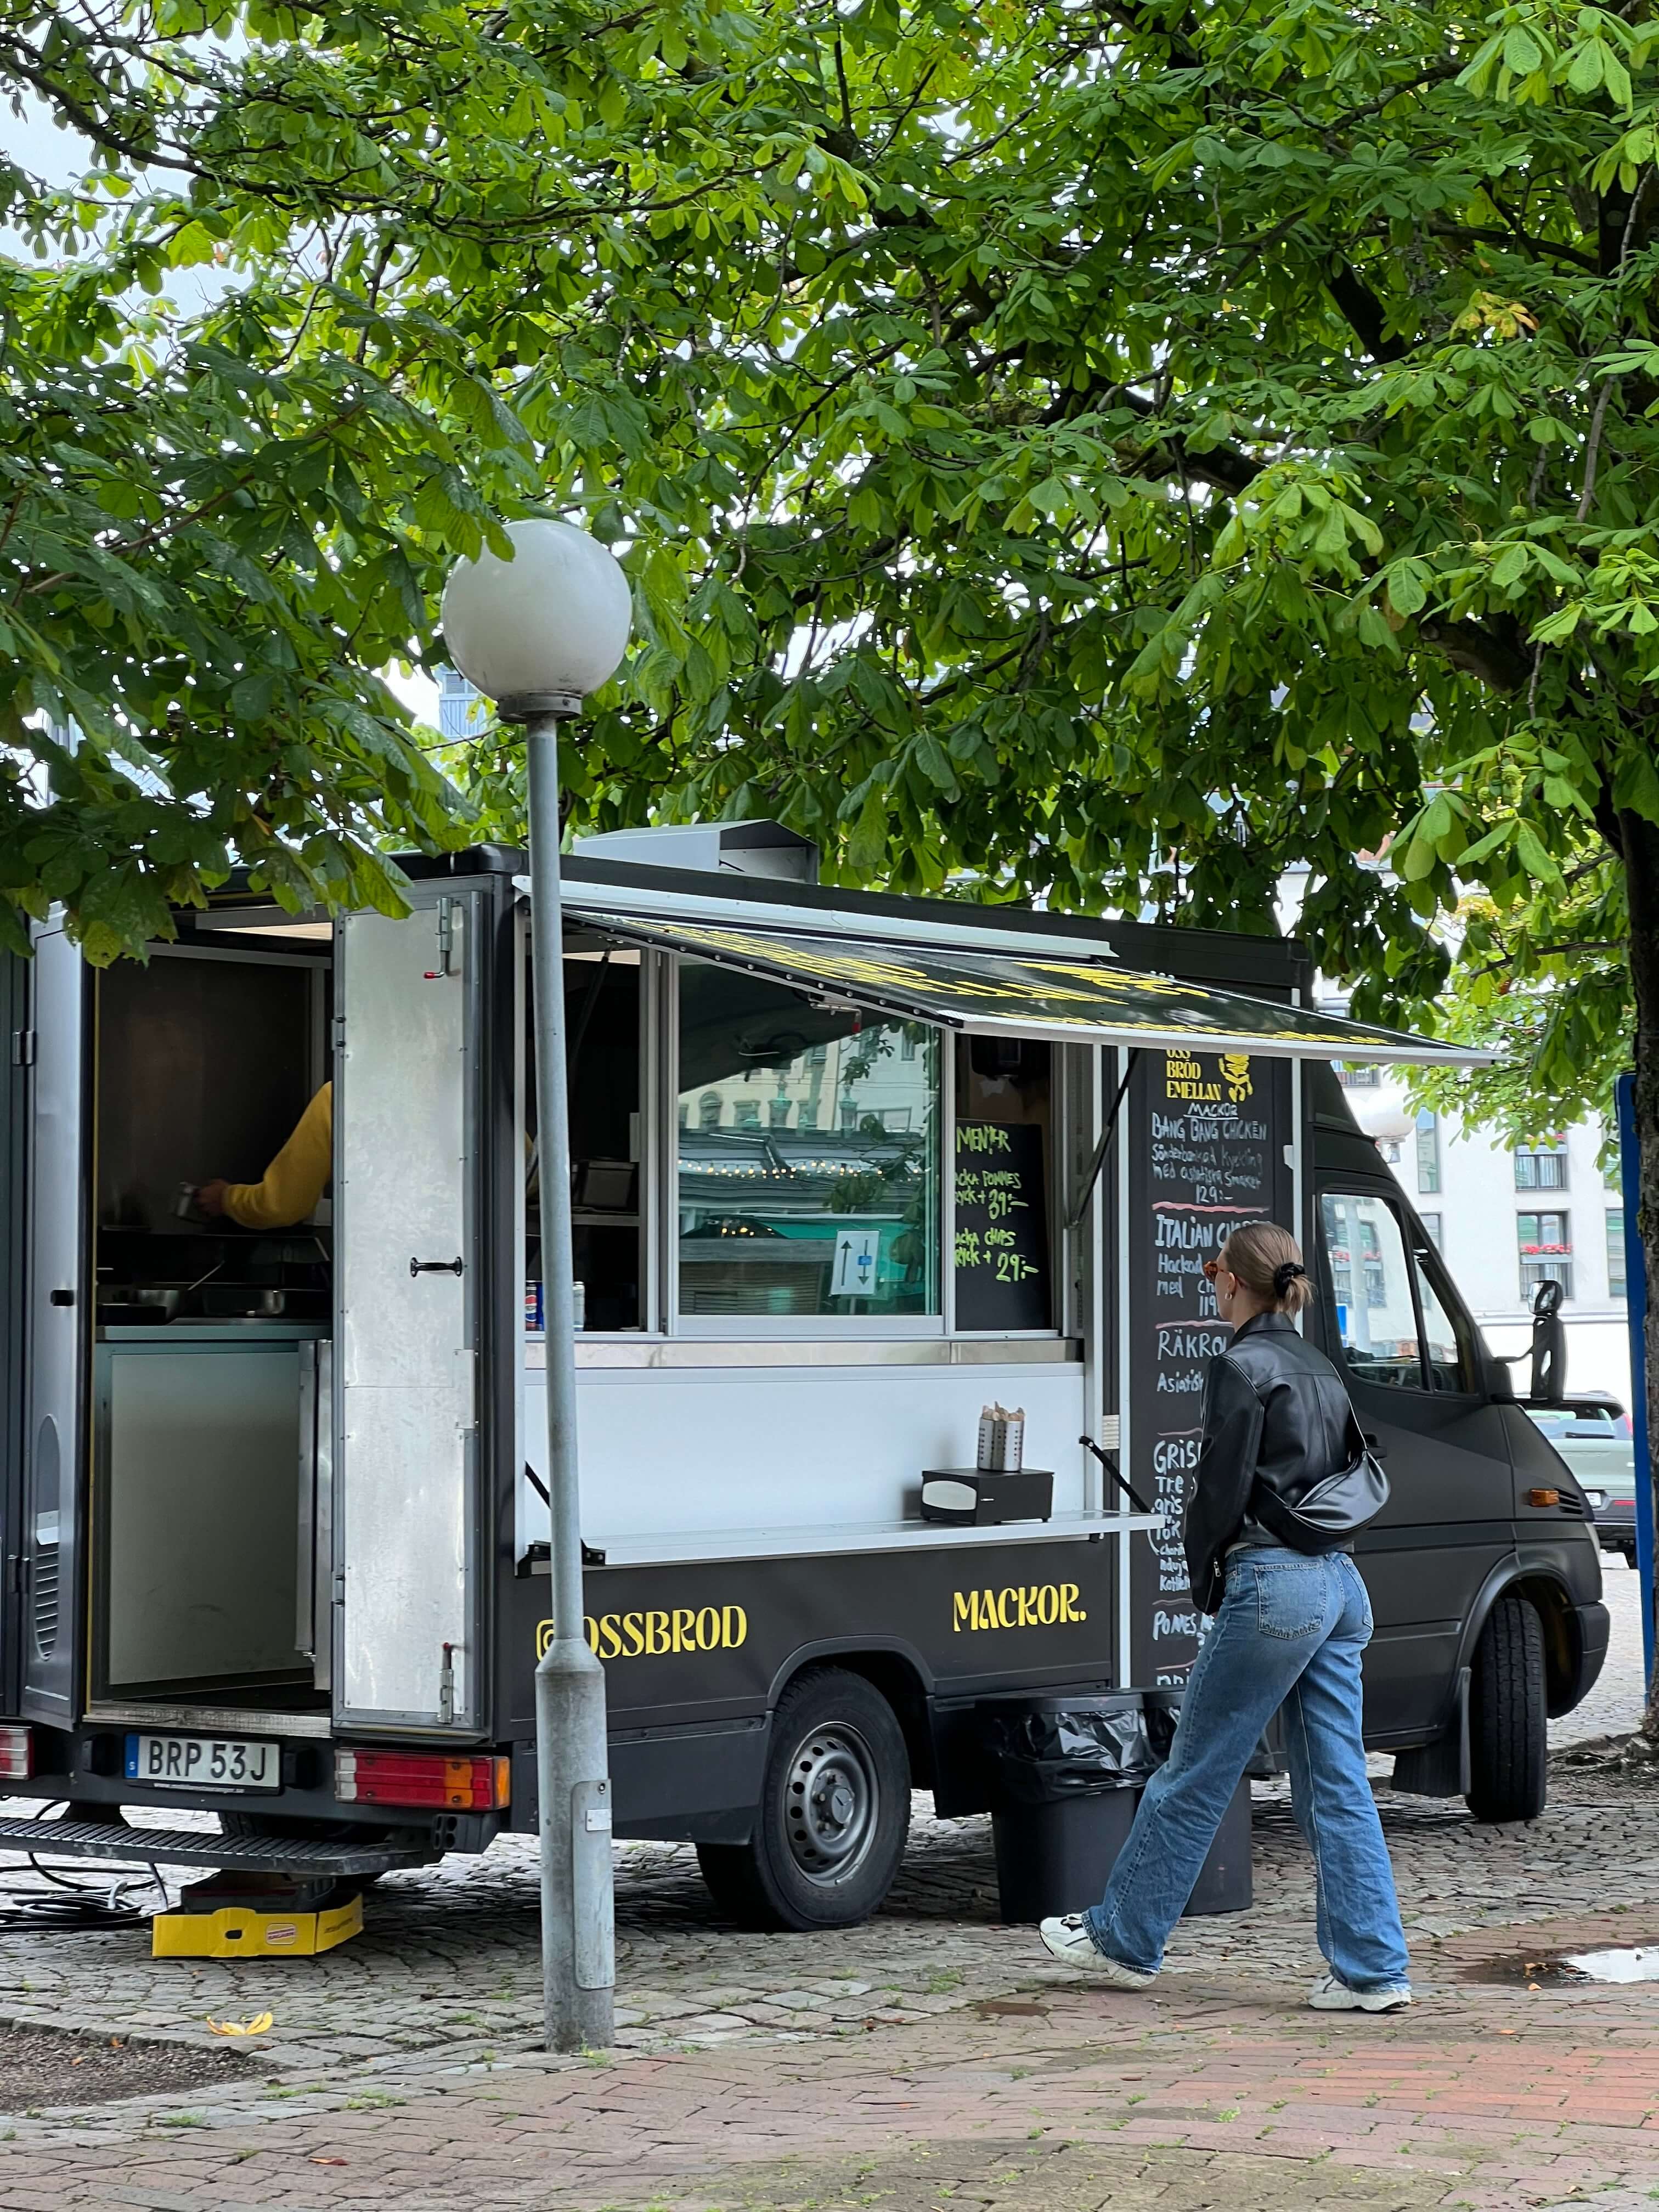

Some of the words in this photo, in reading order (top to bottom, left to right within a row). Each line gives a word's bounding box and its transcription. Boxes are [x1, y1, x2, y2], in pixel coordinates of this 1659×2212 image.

[1166, 1081, 1221, 1101] EMELLAN
[1152, 1112, 1186, 1142] BANG
[128, 1761, 136, 1770] S
[148, 1740, 202, 1777] BRP
[210, 1743, 266, 1781] 53J
